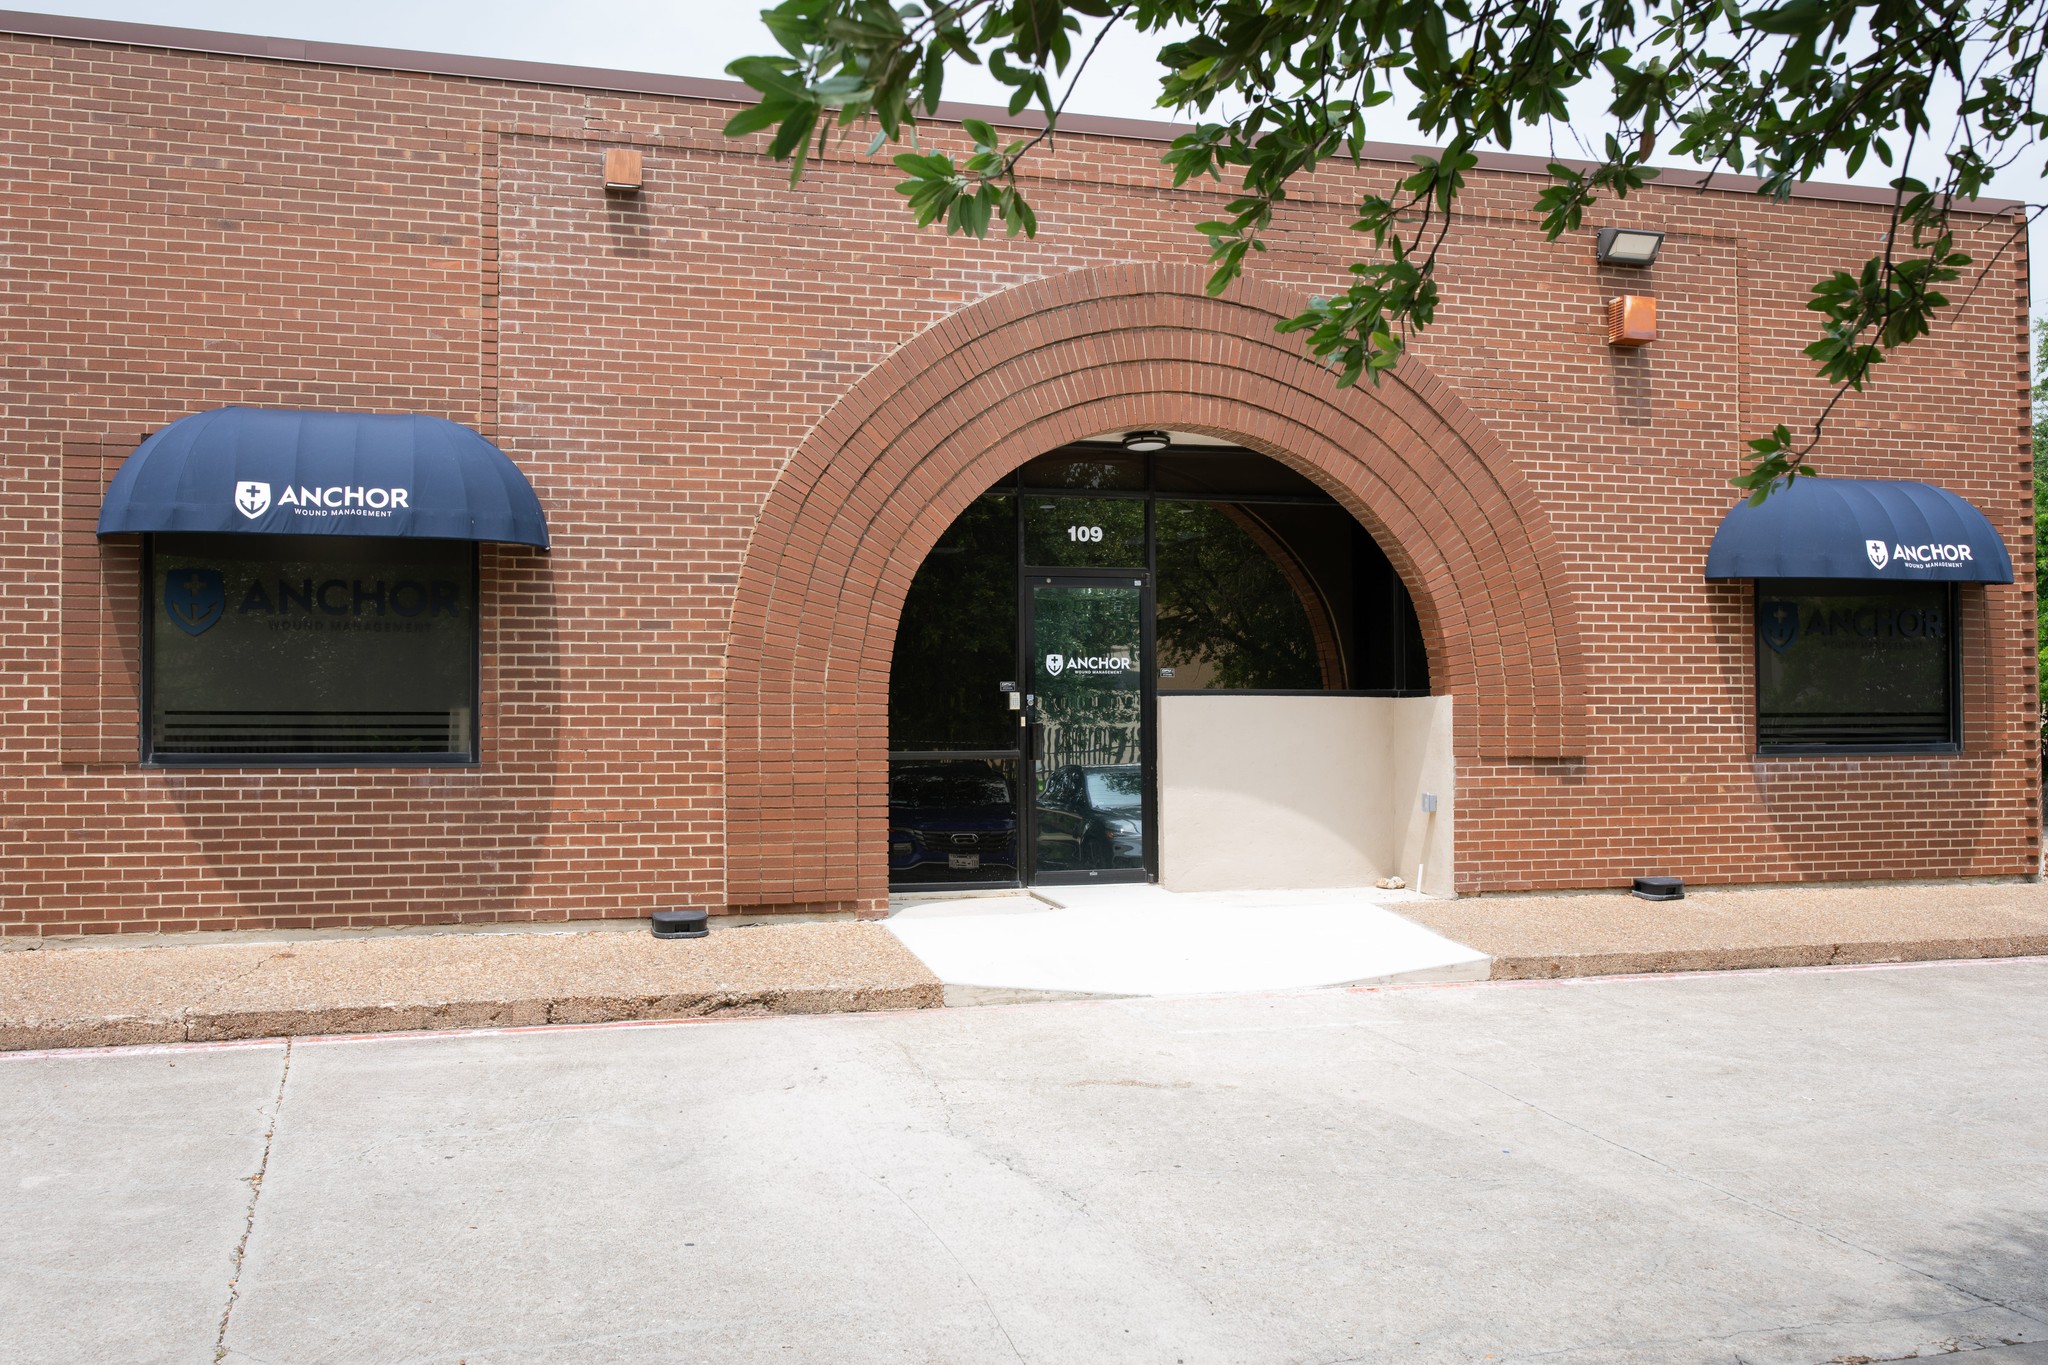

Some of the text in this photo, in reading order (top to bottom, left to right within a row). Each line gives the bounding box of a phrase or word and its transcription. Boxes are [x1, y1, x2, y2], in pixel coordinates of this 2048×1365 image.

[278, 485, 409, 508] ANCHOR
[294, 508, 392, 517] WOUND MANAGEMENT
[1067, 525, 1103, 542] 109
[1893, 543, 1973, 562] ANCHOR
[239, 578, 459, 617] ANCHOR
[268, 620, 432, 632] WOUND MANAGEMENT
[1805, 607, 1943, 638] ANCHOR
[1066, 657, 1130, 669] ANCHOR
